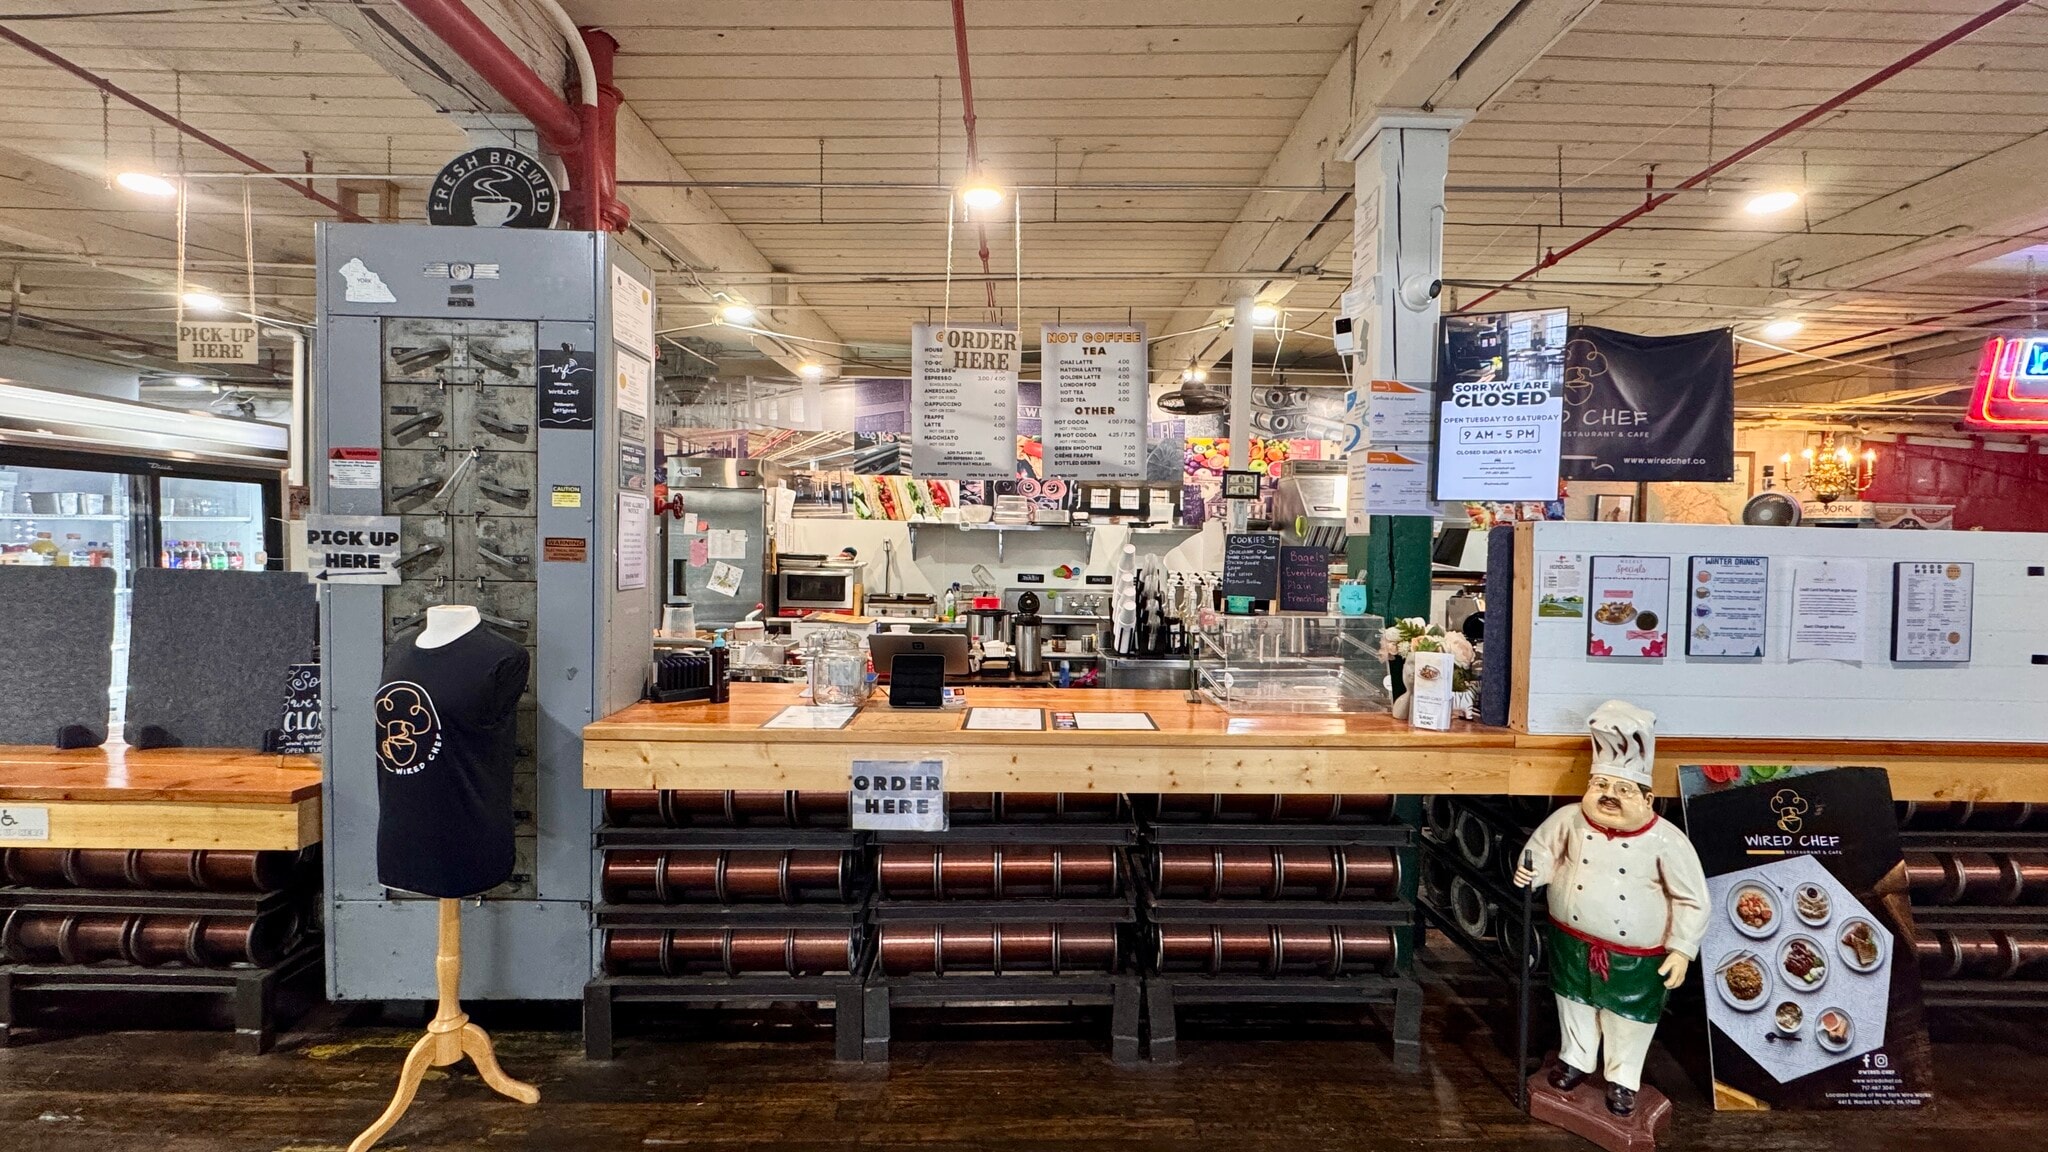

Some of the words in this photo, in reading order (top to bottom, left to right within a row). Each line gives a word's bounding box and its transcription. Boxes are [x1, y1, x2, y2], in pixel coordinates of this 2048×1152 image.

[434, 155, 478, 210] FRESH
[490, 151, 550, 213] BREWED
[180, 326, 255, 342] PICK-UP
[947, 330, 1017, 350] ORDER
[1046, 332, 1078, 343] NOT
[1082, 332, 1141, 342] COFFEE
[192, 344, 244, 358] HERE
[1082, 346, 1106, 355] TEA
[954, 351, 1008, 370] HERE
[1456, 384, 1497, 392] SORRY
[1500, 382, 1521, 390] WE
[1524, 381, 1549, 390] ARE
[1455, 391, 1546, 408] CLOSED
[1075, 407, 1115, 415] OTHER
[1582, 408, 1649, 426] CHEF
[1464, 431, 1471, 439] 9
[1475, 430, 1493, 439] AM
[1506, 430, 1512, 438] 5
[1518, 430, 1534, 438] PM
[1624, 457, 1706, 465] www.wiredchef.co
[308, 530, 364, 545] PICK
[370, 532, 399, 546] UP
[1231, 536, 1265, 544] COOKIES
[326, 554, 380, 568] HERE
[1290, 550, 1325, 563] Bagels
[1286, 567, 1326, 580] Everything
[1616, 564, 1647, 574] Specials
[1288, 580, 1311, 590] Plain
[1287, 592, 1311, 602] French
[396, 762, 425, 775] WIRED
[428, 733, 442, 760] CHEF
[854, 776, 940, 791] ORDER
[865, 799, 928, 814] HERE
[1744, 834, 1792, 846] WIRED
[1799, 835, 1840, 846] CHEF
